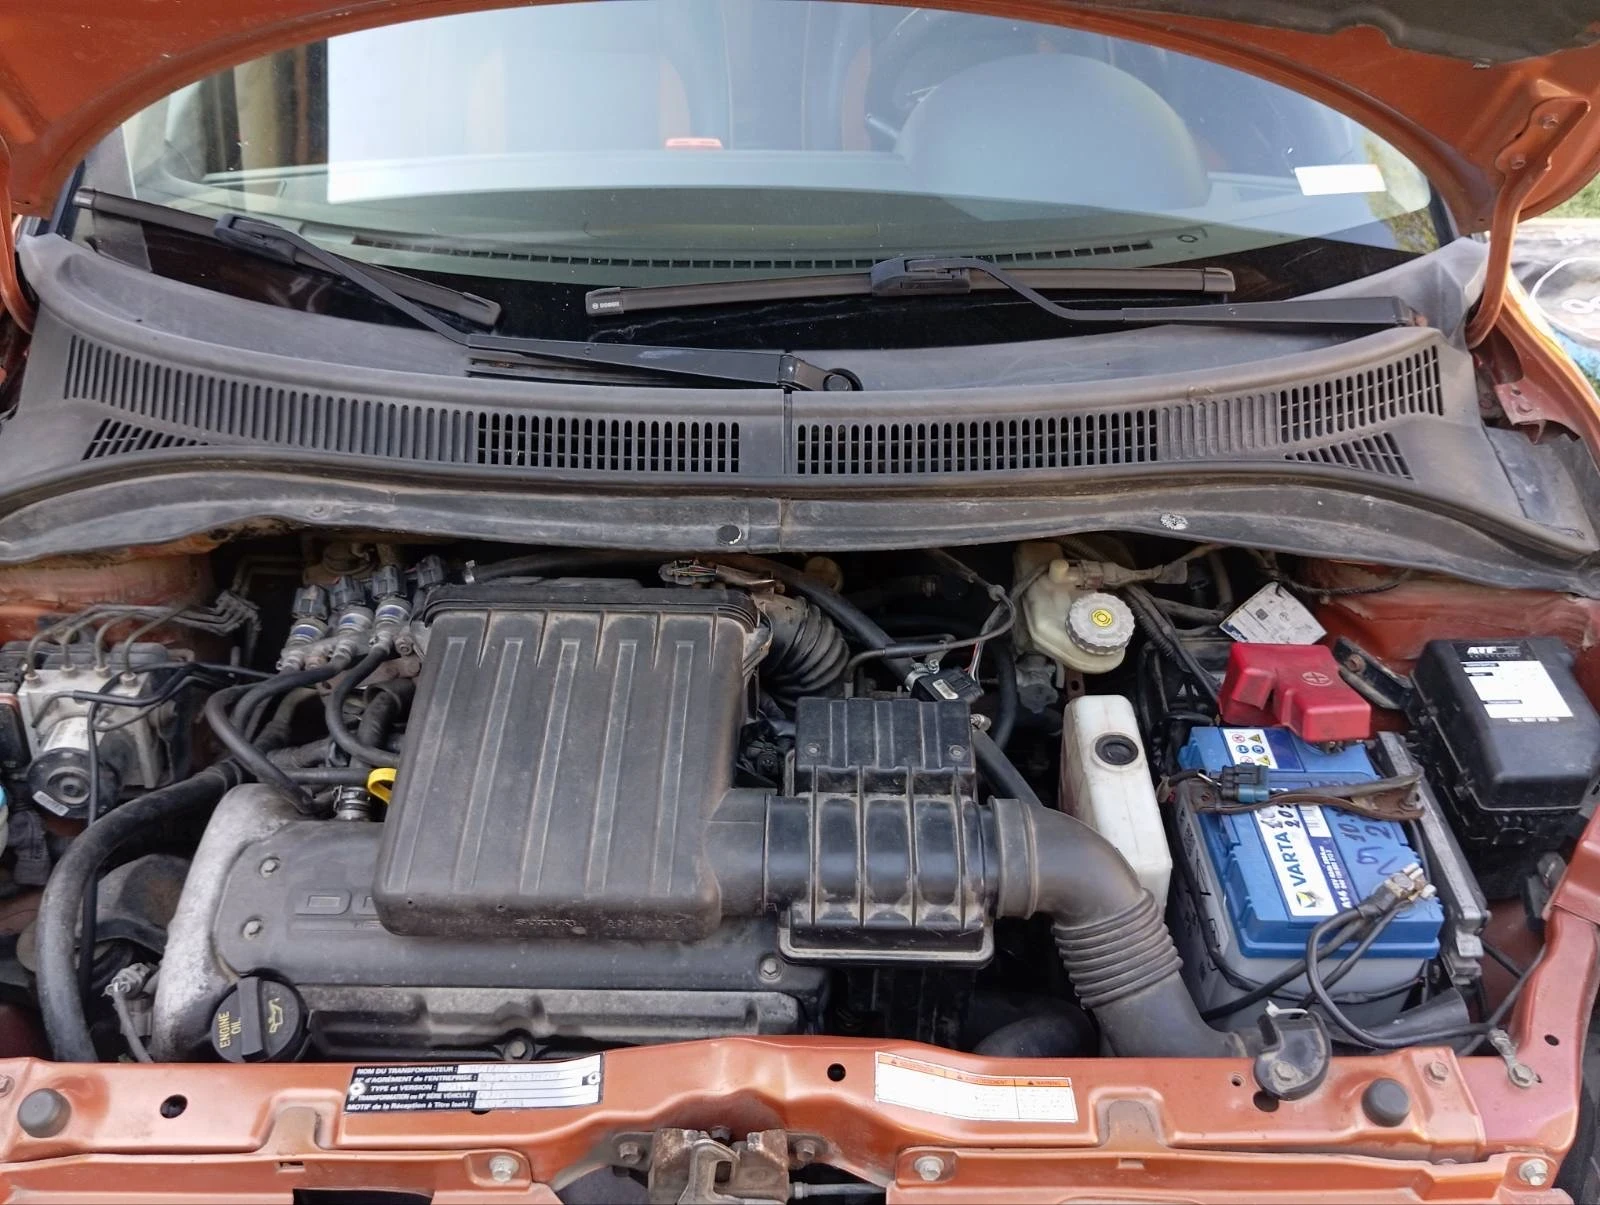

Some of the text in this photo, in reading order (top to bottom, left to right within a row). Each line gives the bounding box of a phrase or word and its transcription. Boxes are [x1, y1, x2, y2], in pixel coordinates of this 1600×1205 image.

[1274, 831, 1307, 887] VARTA
[218, 1011, 231, 1049] ENGINE
[230, 1017, 242, 1035] OIL
[388, 1066, 454, 1074] TRANSFORMATEUR
